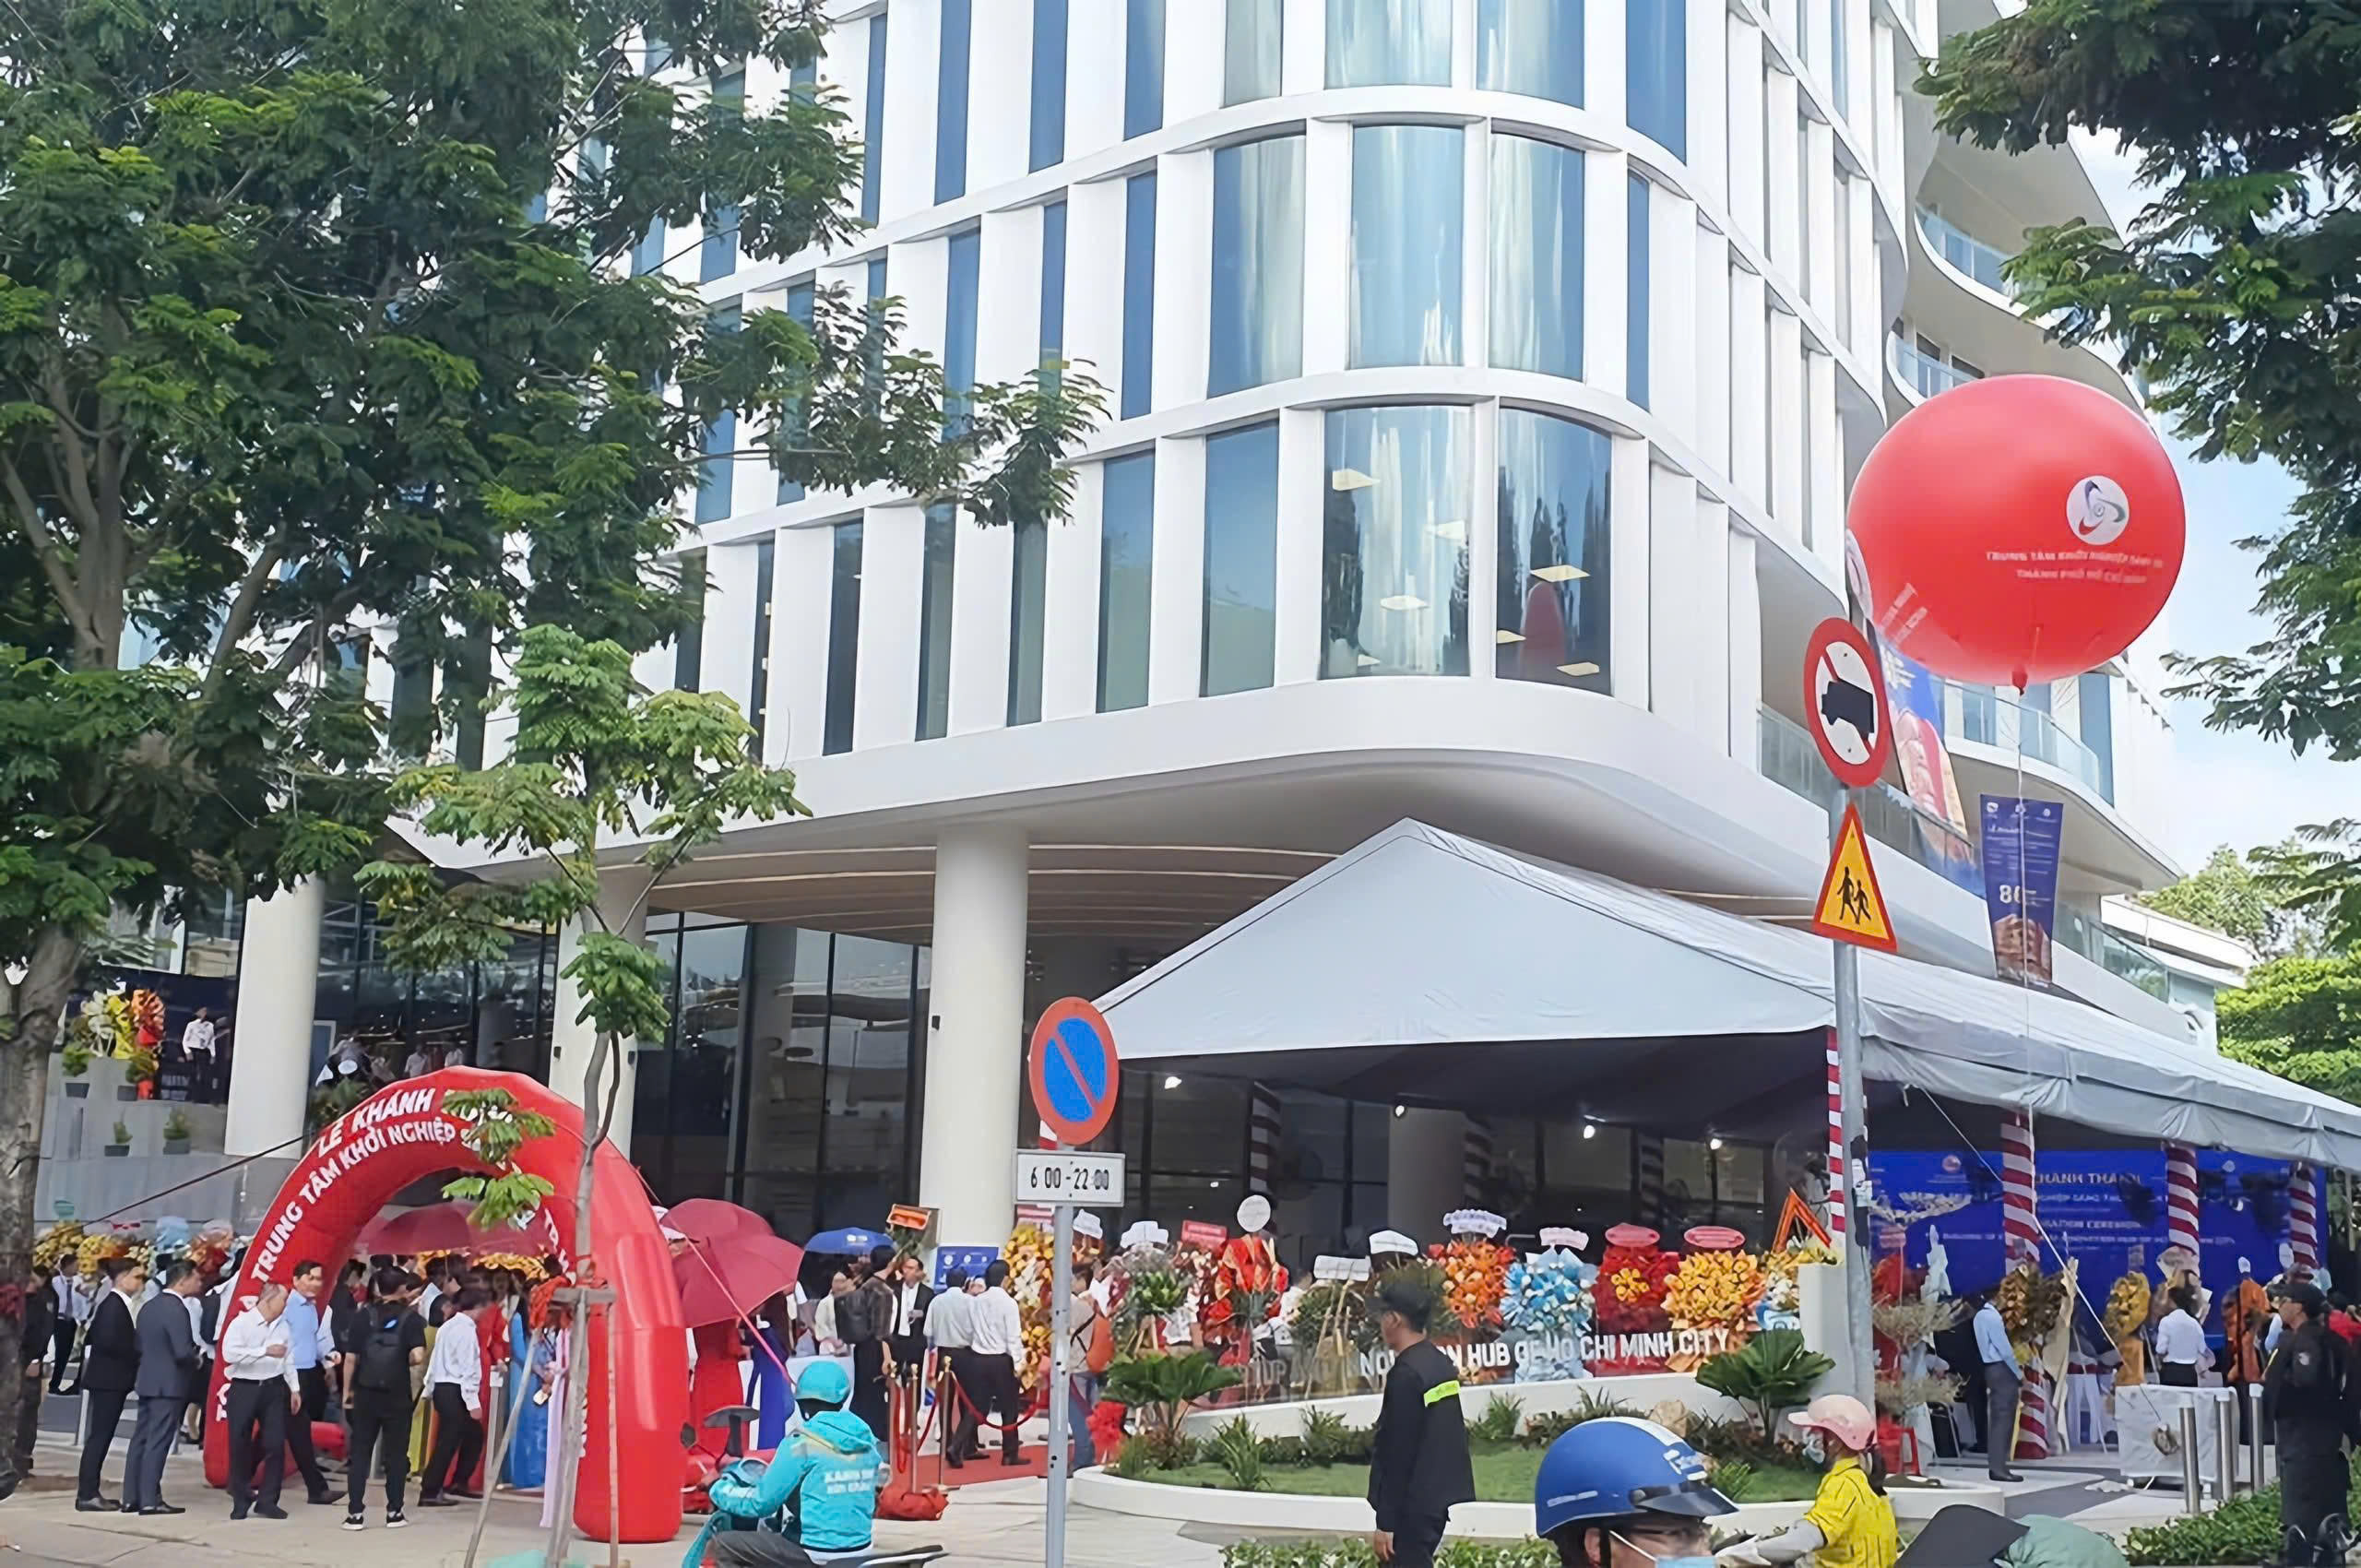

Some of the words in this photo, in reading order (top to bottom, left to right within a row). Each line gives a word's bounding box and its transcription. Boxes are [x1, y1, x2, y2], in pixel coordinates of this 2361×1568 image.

[351, 1088, 435, 1134] KHÁNH
[251, 1201, 303, 1283] TRUNG
[299, 1158, 342, 1205] TÂM
[338, 1124, 386, 1170] KHỞI
[387, 1117, 456, 1146] NGHIỆP
[1467, 1342, 1511, 1367] HUB
[1580, 1334, 1615, 1360] CHI
[1619, 1331, 1673, 1359] MINH
[1679, 1327, 1728, 1357] CITY
